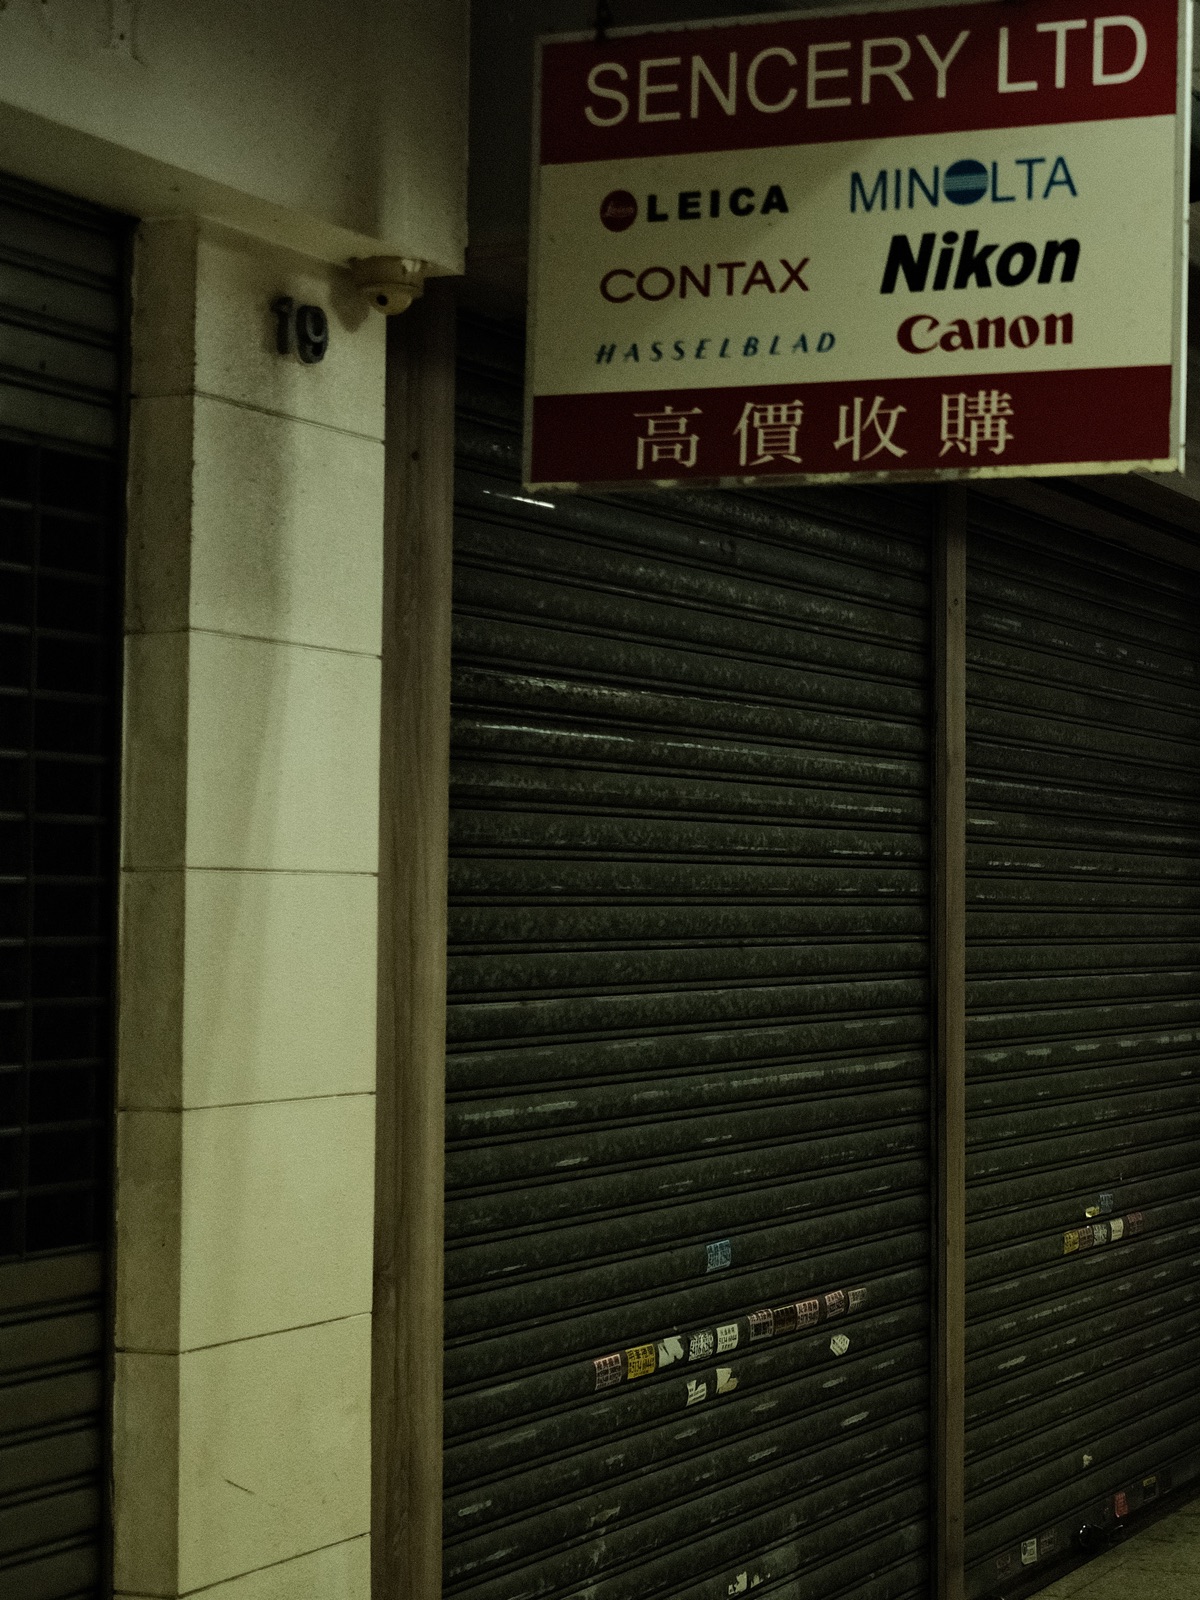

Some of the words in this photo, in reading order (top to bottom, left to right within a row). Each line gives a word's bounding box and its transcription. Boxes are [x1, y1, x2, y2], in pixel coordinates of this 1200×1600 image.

[583, 30, 970, 127] SENCERY
[998, 15, 1149, 95] LTD
[646, 185, 790, 223] LEICA
[849, 156, 1078, 214] MINOLTA
[599, 257, 811, 304] CONTAX
[879, 229, 1081, 295] Nikon
[270, 295, 330, 366] 19
[594, 330, 838, 366] HASSELBLAD
[896, 311, 1075, 355] Canon
[632, 388, 1015, 471] 高價收購
